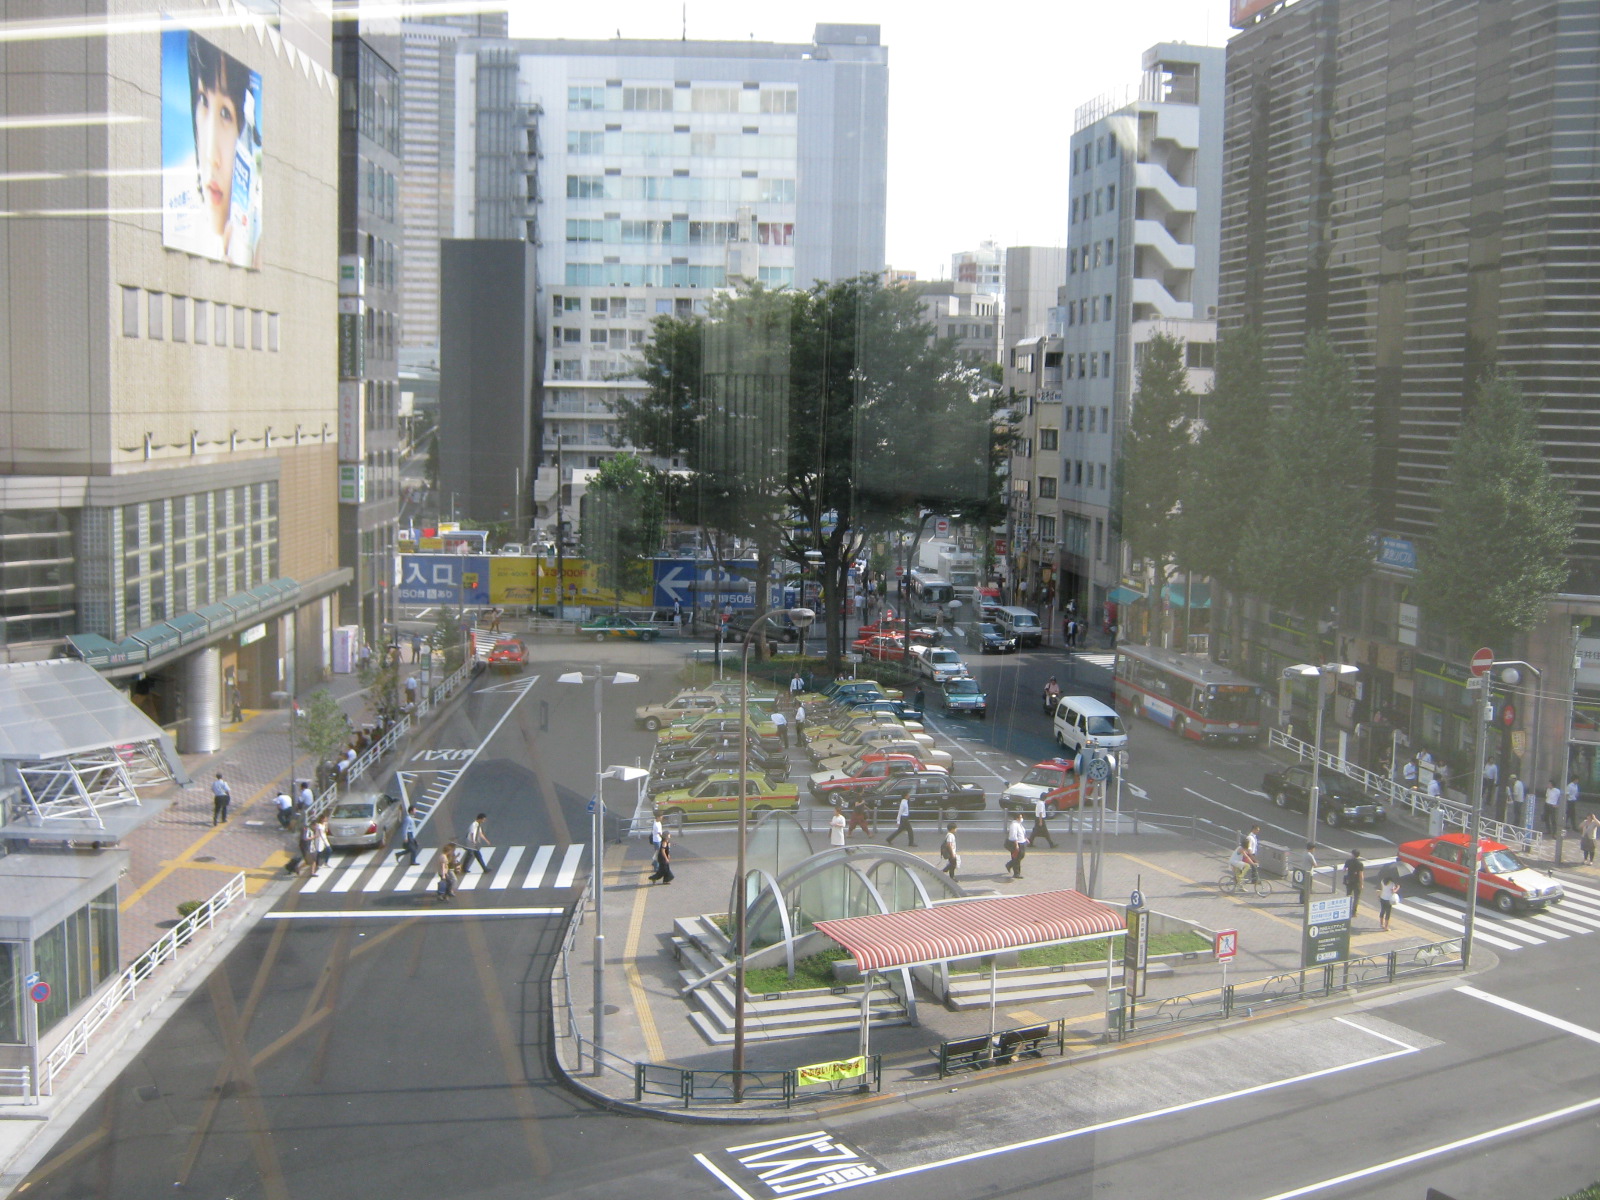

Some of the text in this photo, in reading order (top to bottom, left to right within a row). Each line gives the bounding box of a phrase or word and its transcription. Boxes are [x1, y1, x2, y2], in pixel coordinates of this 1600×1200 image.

[406, 562, 453, 584] 入口
[1132, 892, 1140, 905] 3
[725, 1130, 878, 1193] バス停
